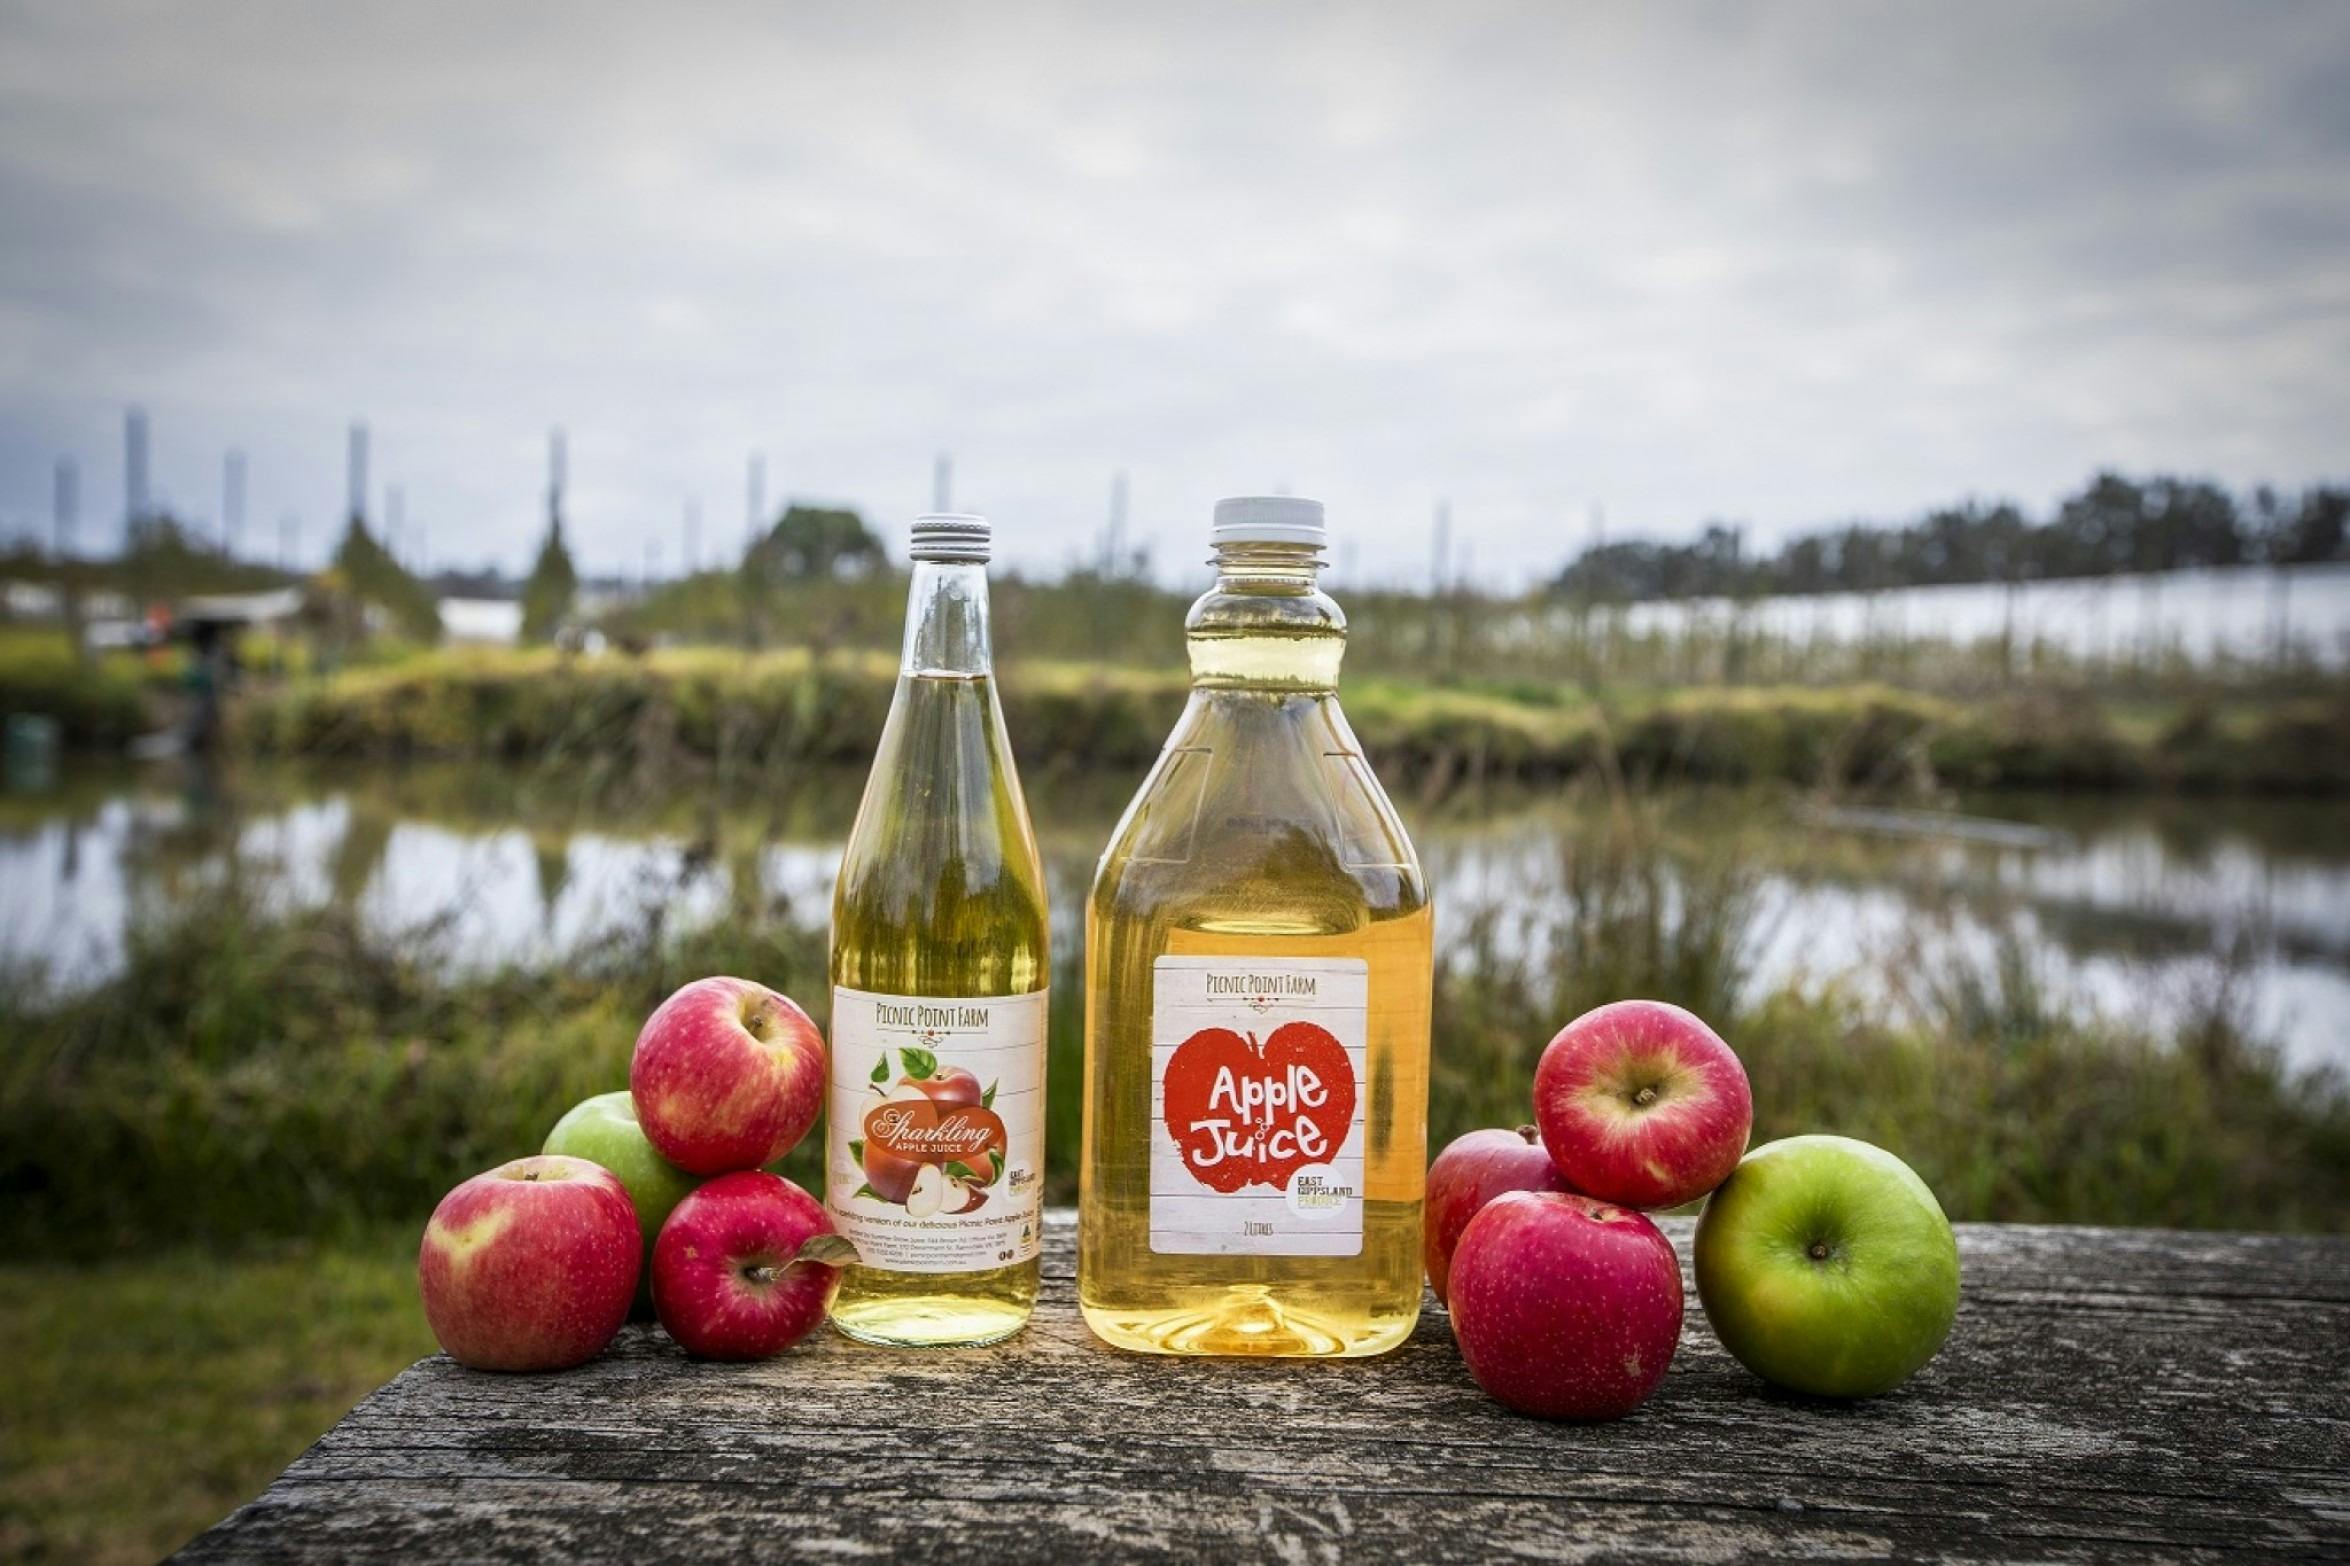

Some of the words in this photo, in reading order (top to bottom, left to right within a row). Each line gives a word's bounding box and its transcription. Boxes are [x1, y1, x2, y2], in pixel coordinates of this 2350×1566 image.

[1208, 1064, 1328, 1126] Apple
[872, 1108, 992, 1153] Sparkling
[1190, 1115, 1328, 1168] Juice
[896, 1143, 927, 1153] APPLE
[931, 1143, 962, 1153] JUICE
[1297, 1176, 1324, 1187] EAST
[893, 1219, 902, 1229] of
[959, 1219, 984, 1228] Picnic
